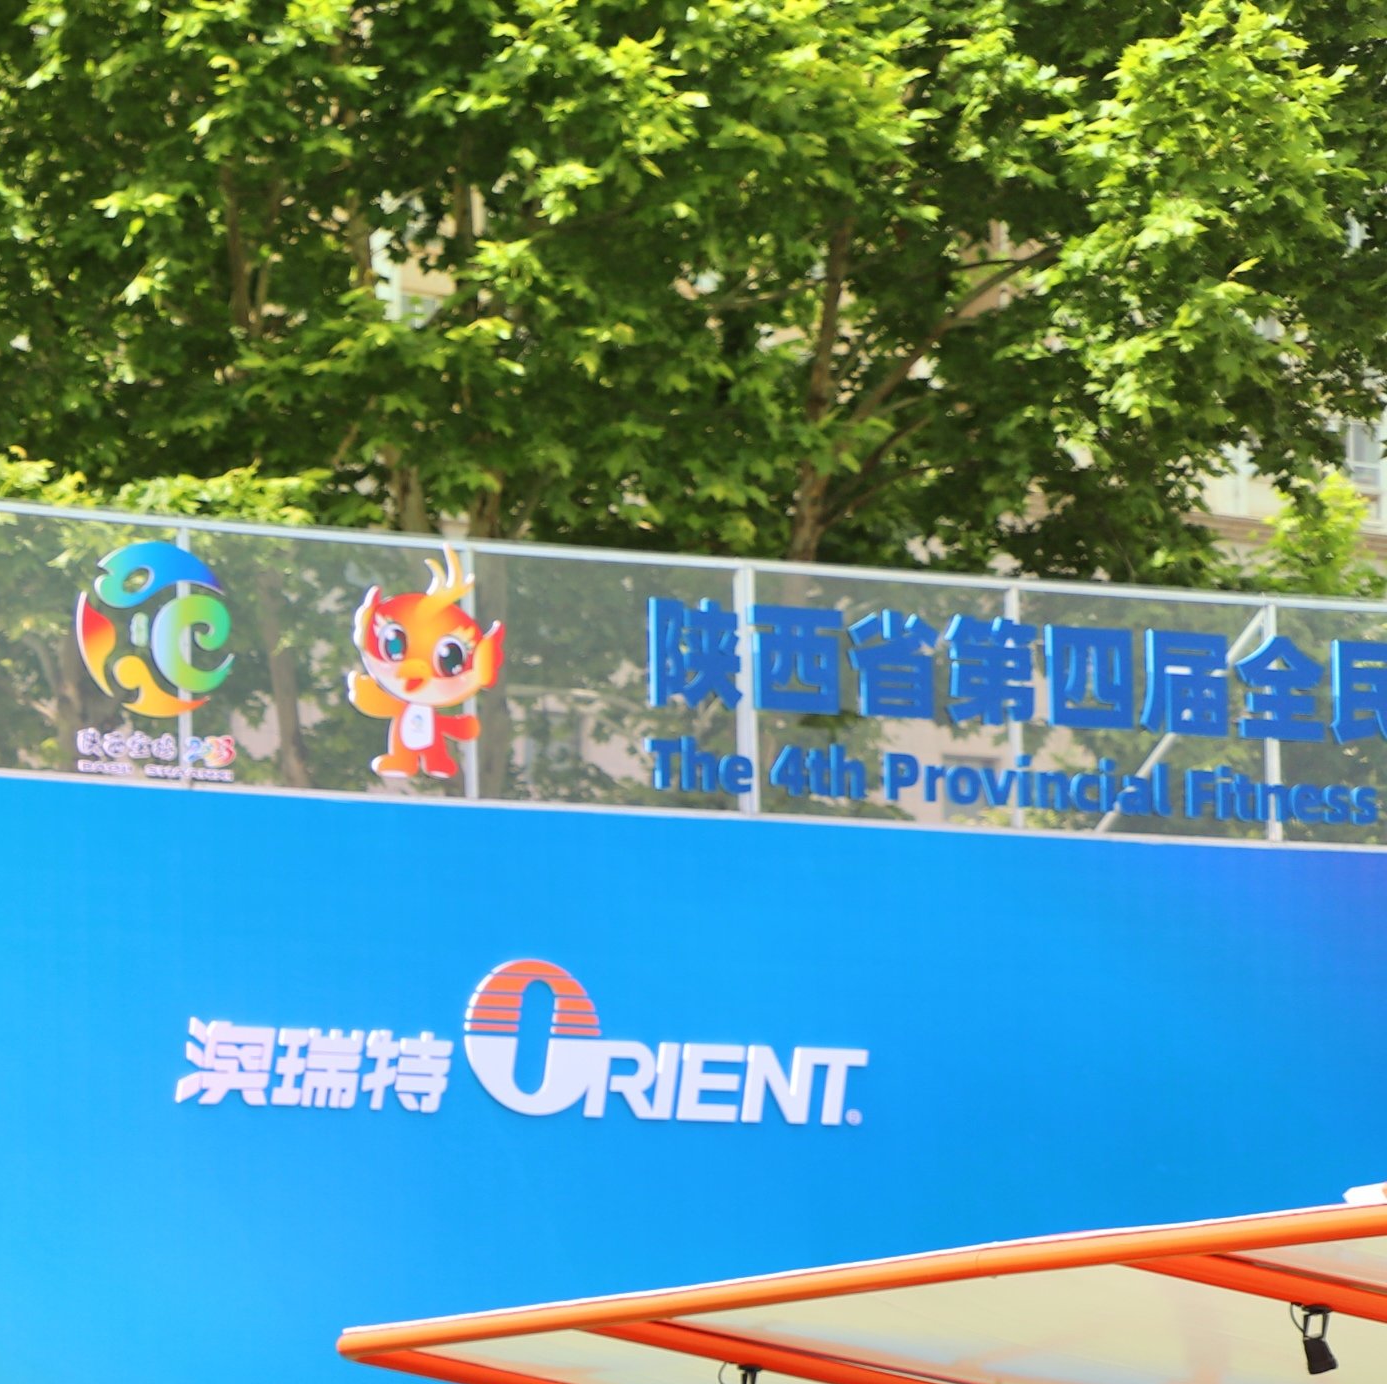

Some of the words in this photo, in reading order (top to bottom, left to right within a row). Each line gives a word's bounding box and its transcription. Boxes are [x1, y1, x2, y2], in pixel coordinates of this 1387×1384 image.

[645, 736, 755, 795] The
[770, 742, 868, 800] 4th
[882, 750, 1173, 820] Provincial
[1184, 764, 1379, 827] Fitness
[175, 1016, 454, 1113] 澳瑞特
[464, 959, 869, 1126] ORIENT
